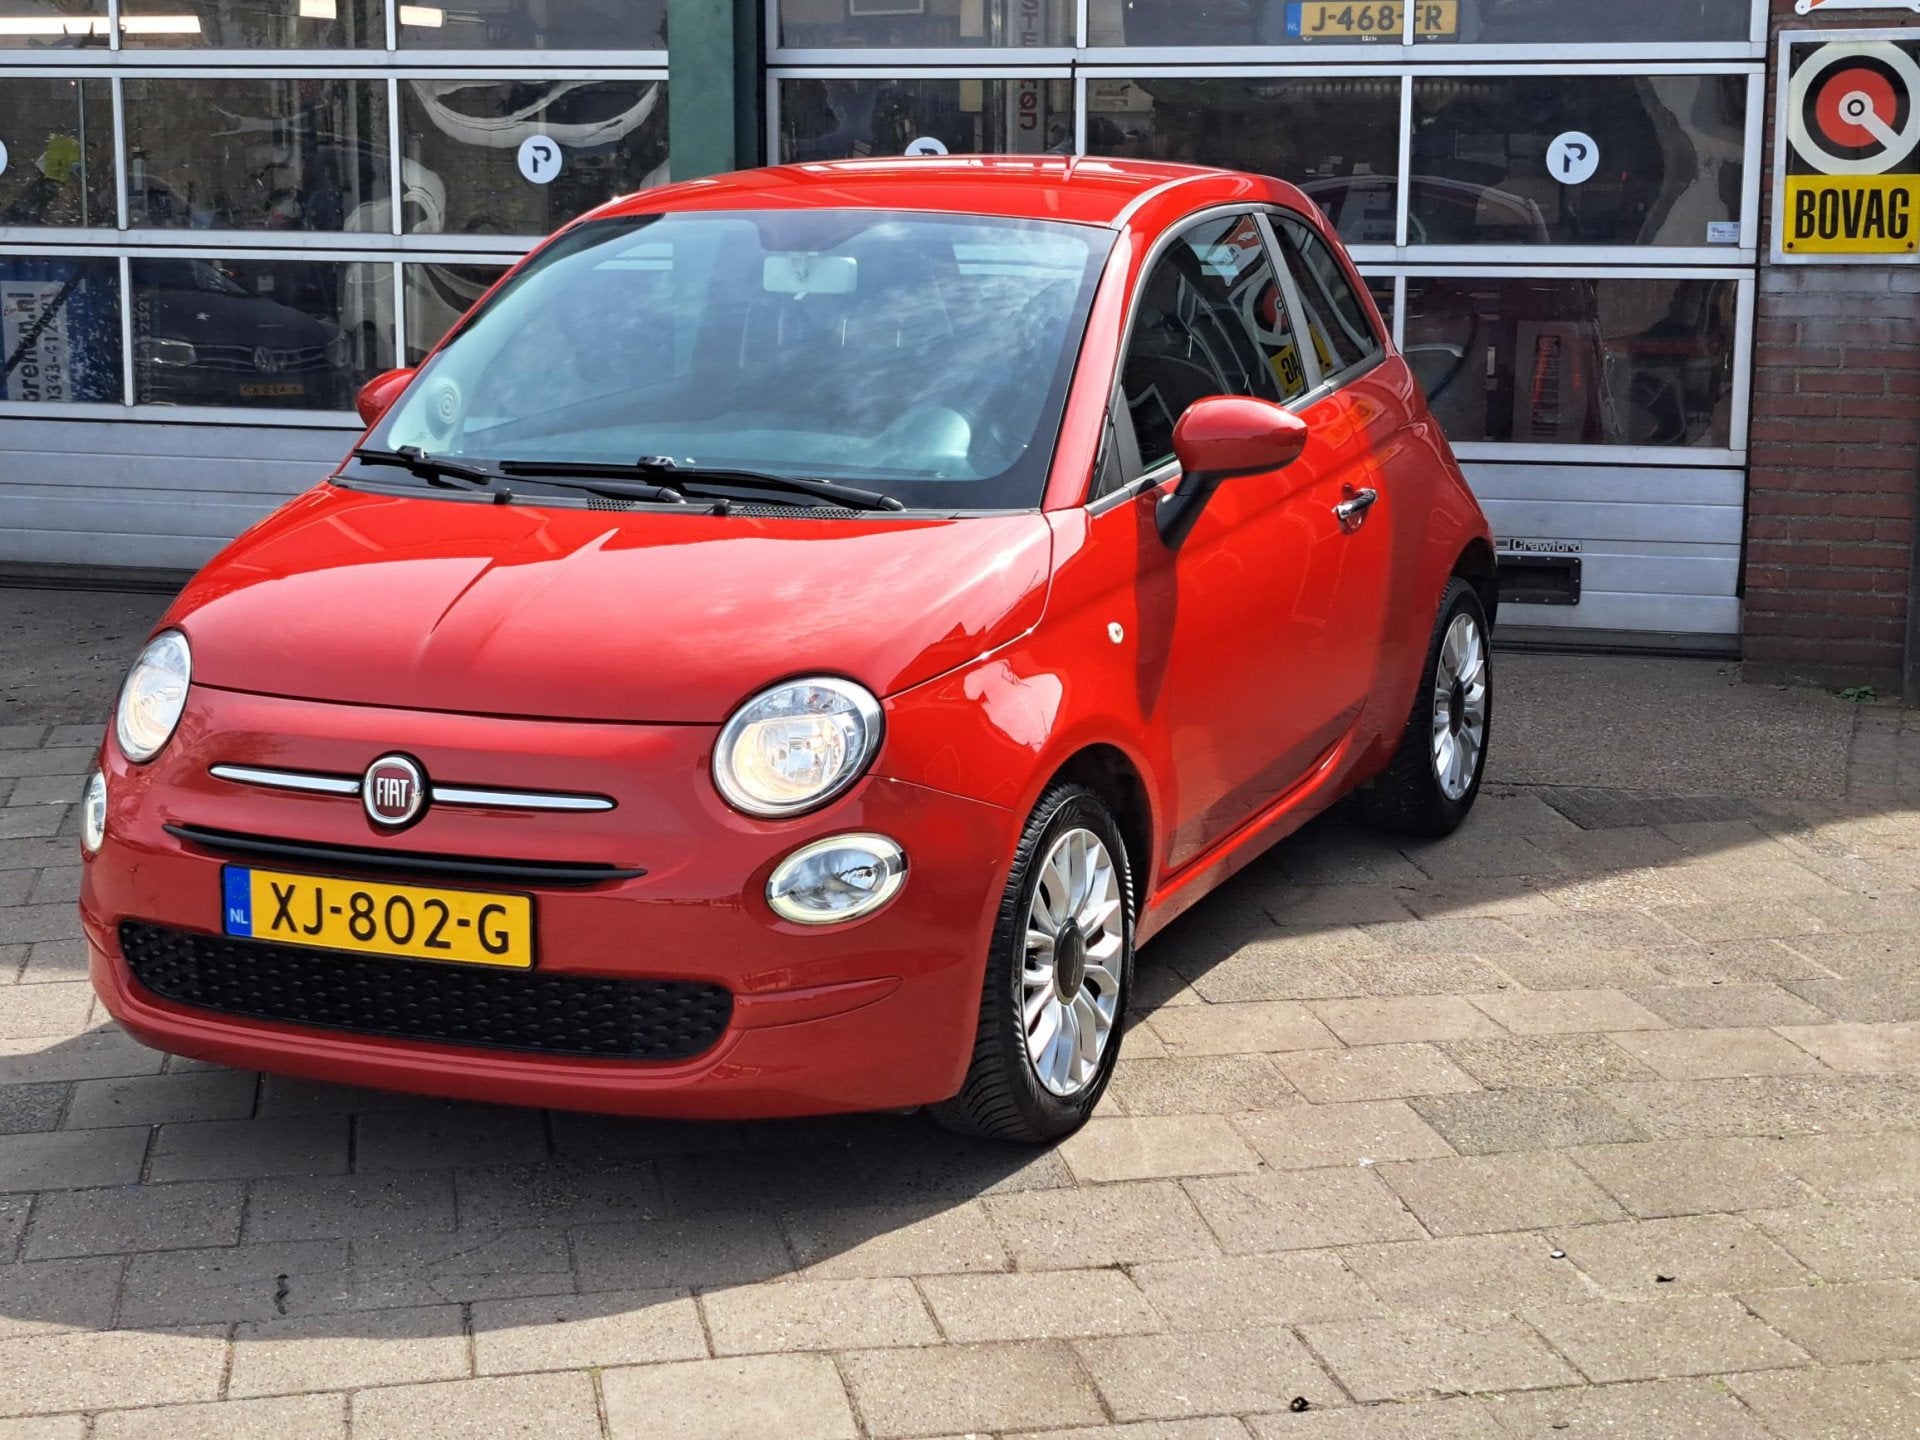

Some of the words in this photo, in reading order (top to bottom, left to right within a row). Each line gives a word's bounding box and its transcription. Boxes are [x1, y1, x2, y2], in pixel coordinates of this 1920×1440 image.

[1287, 22, 1300, 31] NL
[1794, 187, 1910, 240] BOVAG
[1512, 539, 1582, 553] Crawford
[376, 777, 410, 808] FIAT
[229, 908, 249, 925] NL
[270, 882, 510, 955] XJ-802-G
